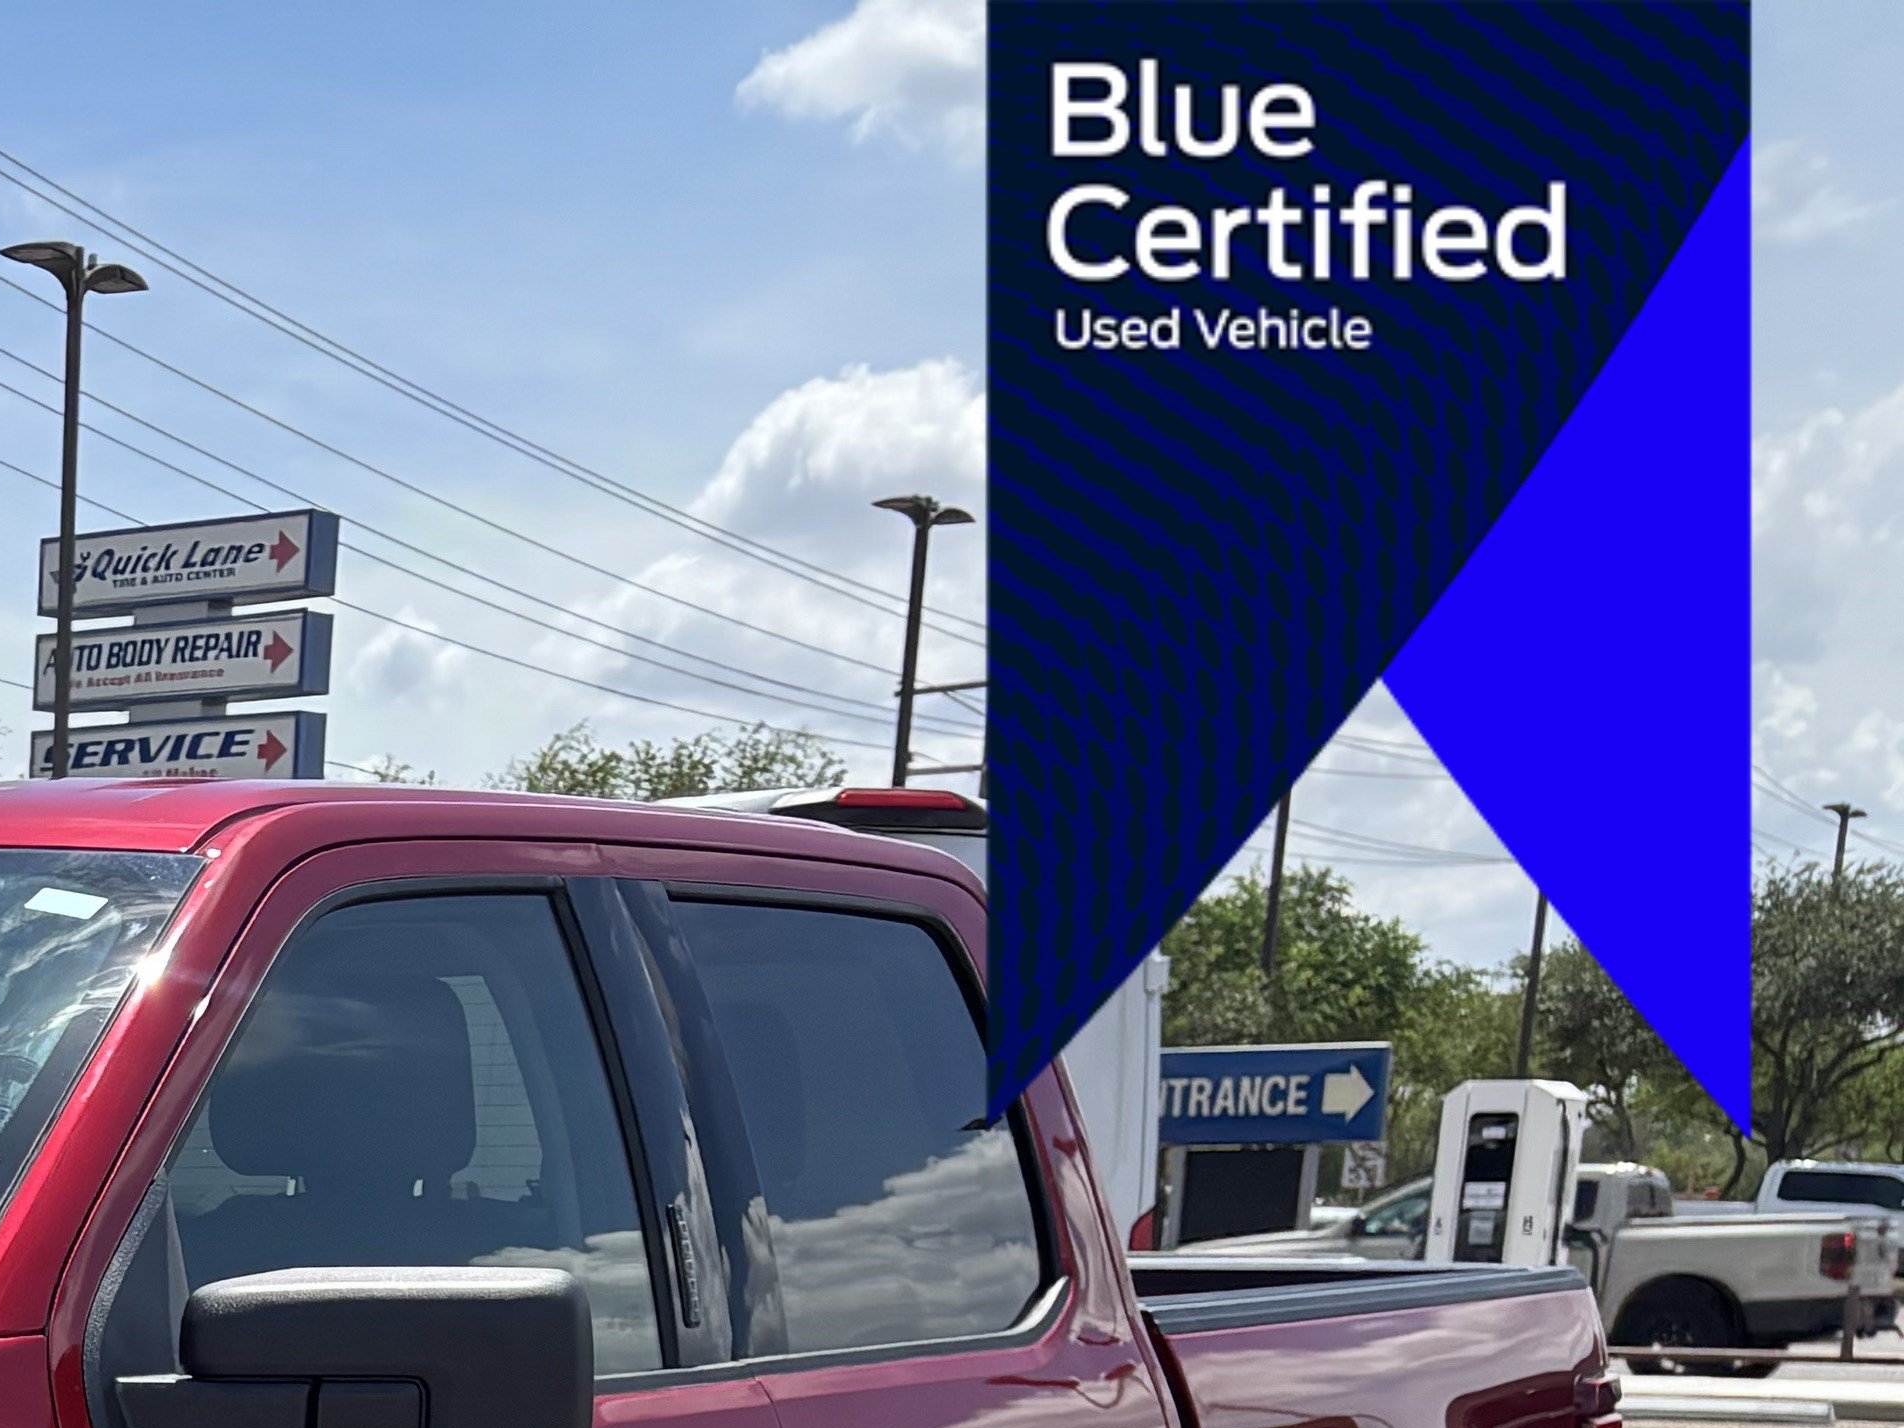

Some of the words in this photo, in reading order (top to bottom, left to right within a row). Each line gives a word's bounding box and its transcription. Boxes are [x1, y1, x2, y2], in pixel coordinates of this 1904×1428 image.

[92, 543, 178, 582] Quick
[181, 540, 266, 570] Lane
[151, 571, 184, 585] AUTO
[186, 567, 236, 581] CENTER
[42, 642, 103, 675] ATO
[106, 636, 170, 669] BODY
[171, 629, 263, 664] REPAIR
[1159, 1074, 1311, 1118] TRANCE
